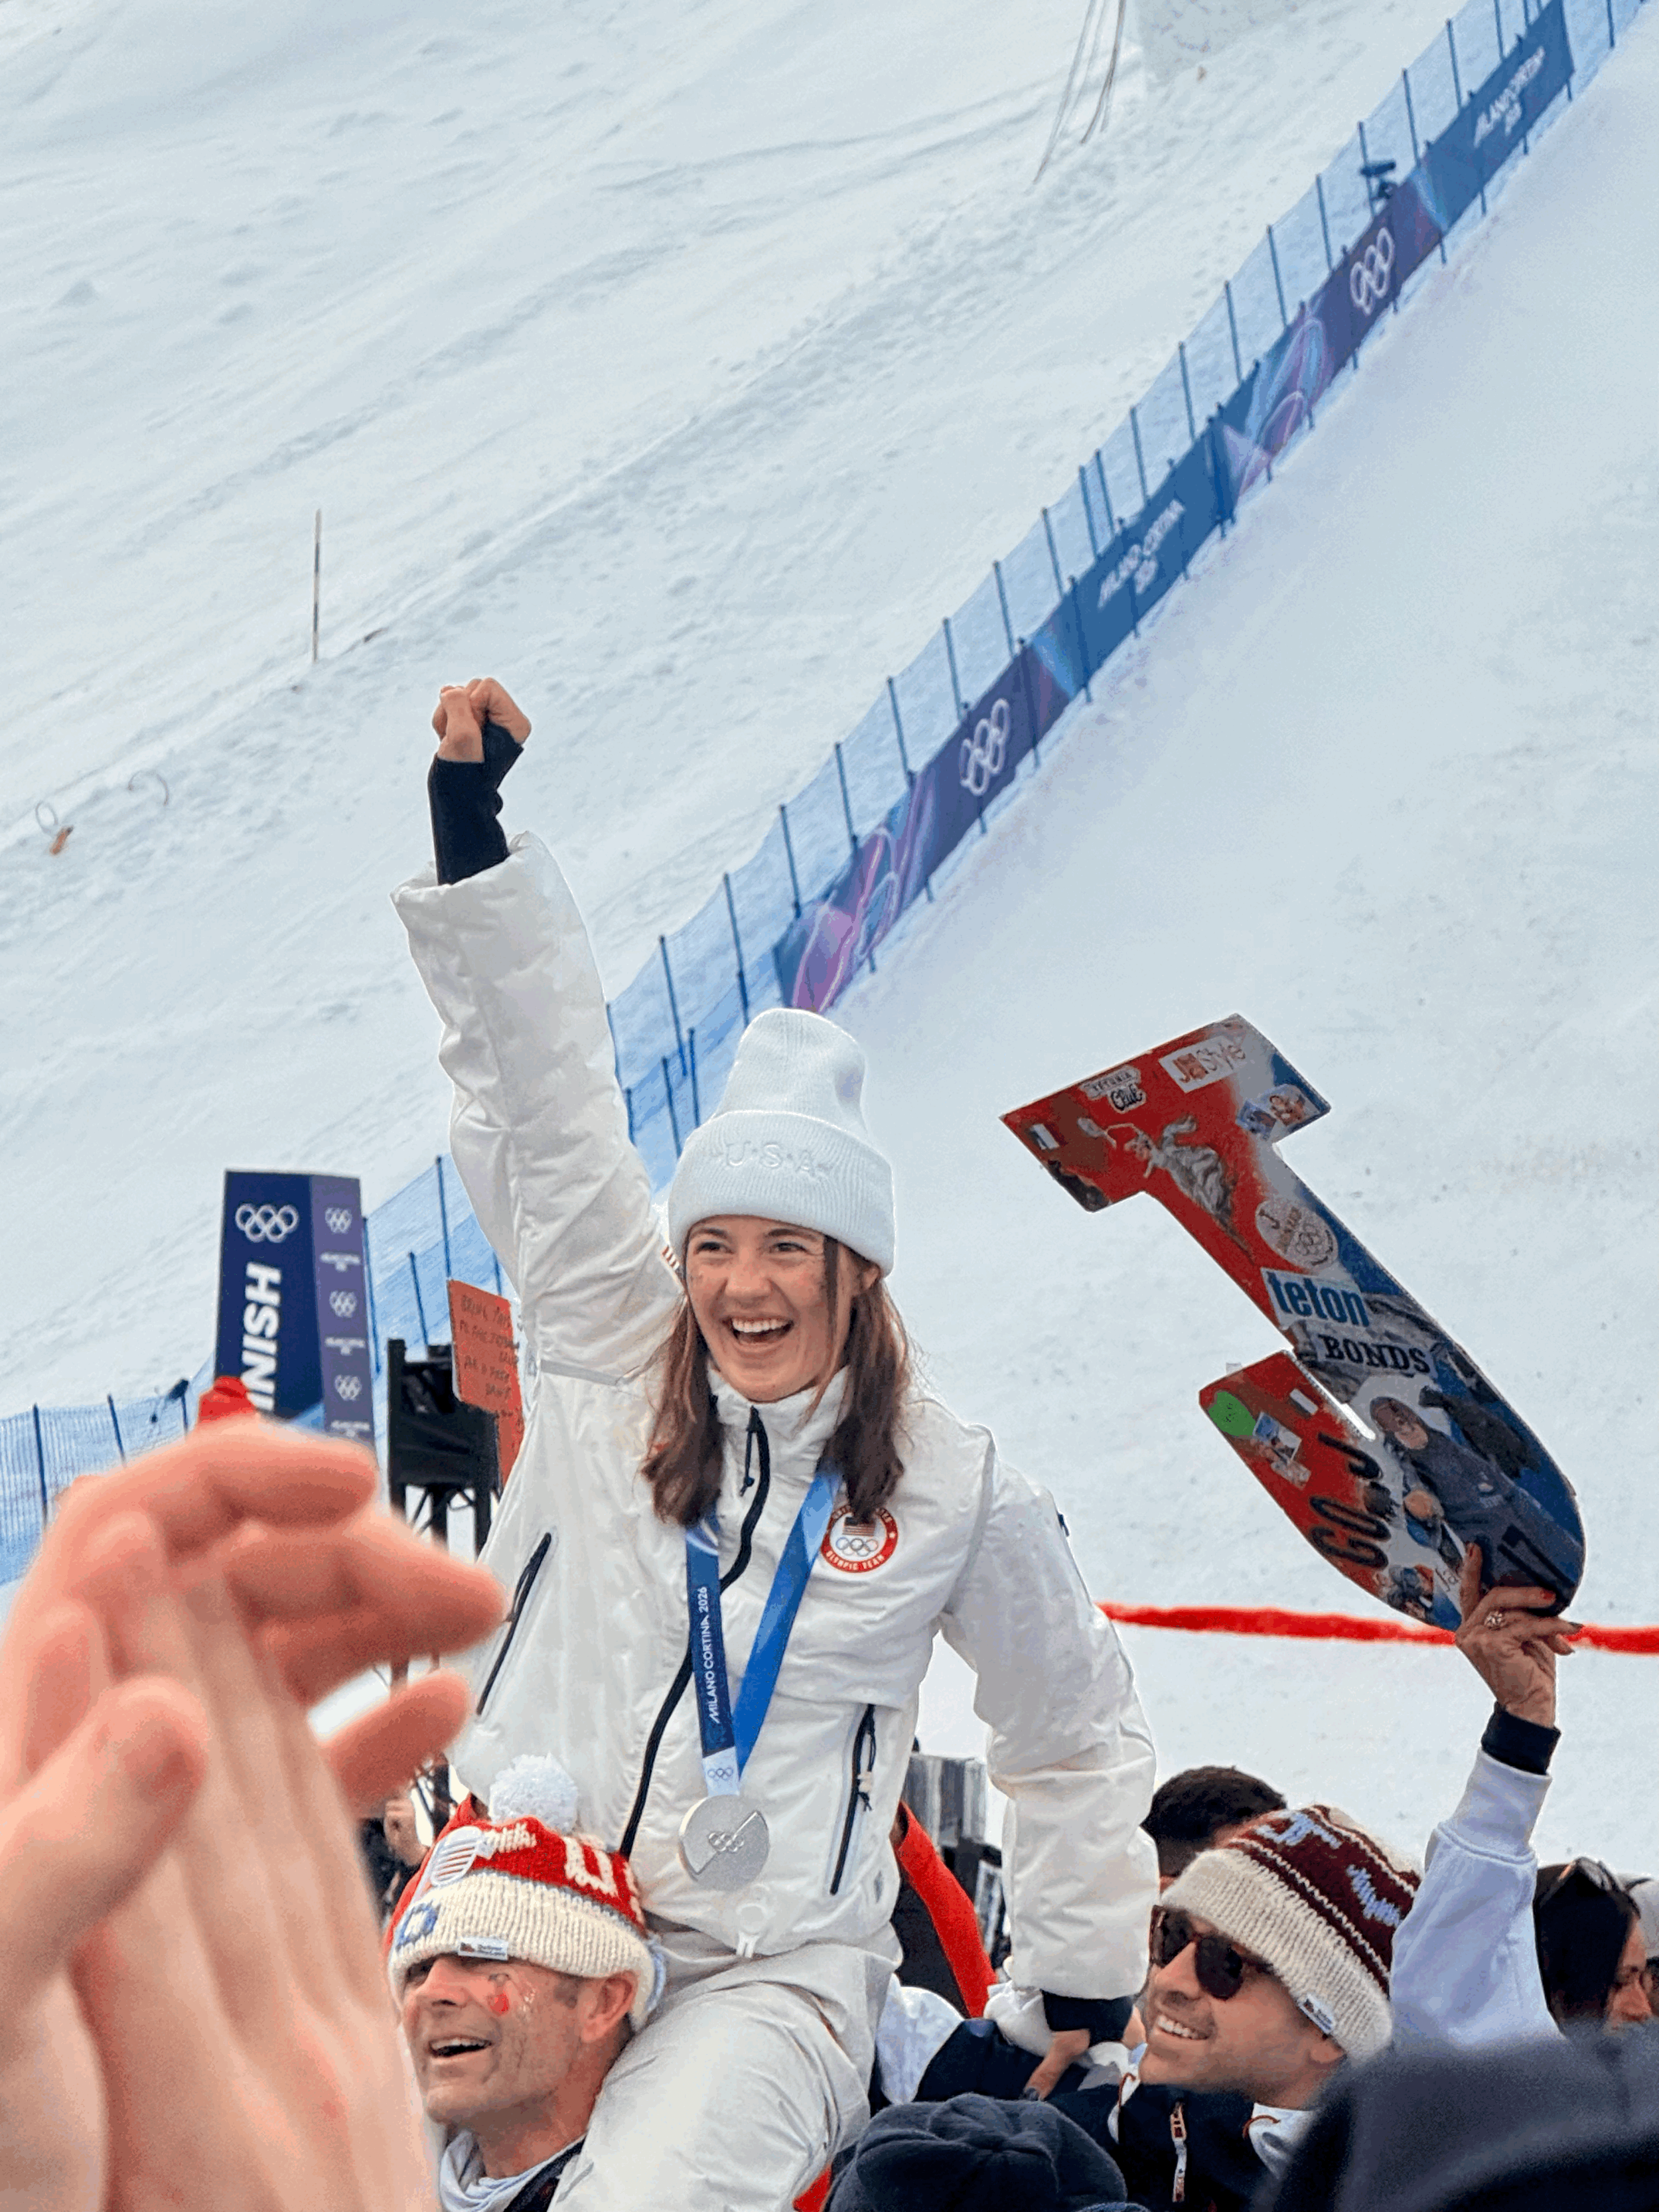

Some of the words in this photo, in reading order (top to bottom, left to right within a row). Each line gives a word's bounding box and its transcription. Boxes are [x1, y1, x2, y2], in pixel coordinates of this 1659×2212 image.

[1265, 1270, 1370, 1327] teton
[240, 1261, 282, 1412] INISH
[1317, 1333, 1431, 1374] BONDS
[826, 1550, 859, 1571] OLYMPIC
[861, 1554, 885, 1570] TEAM
[698, 1586, 709, 1613] 2026
[700, 1615, 714, 1670] CORTINA
[705, 1670, 720, 1725] MILANO
